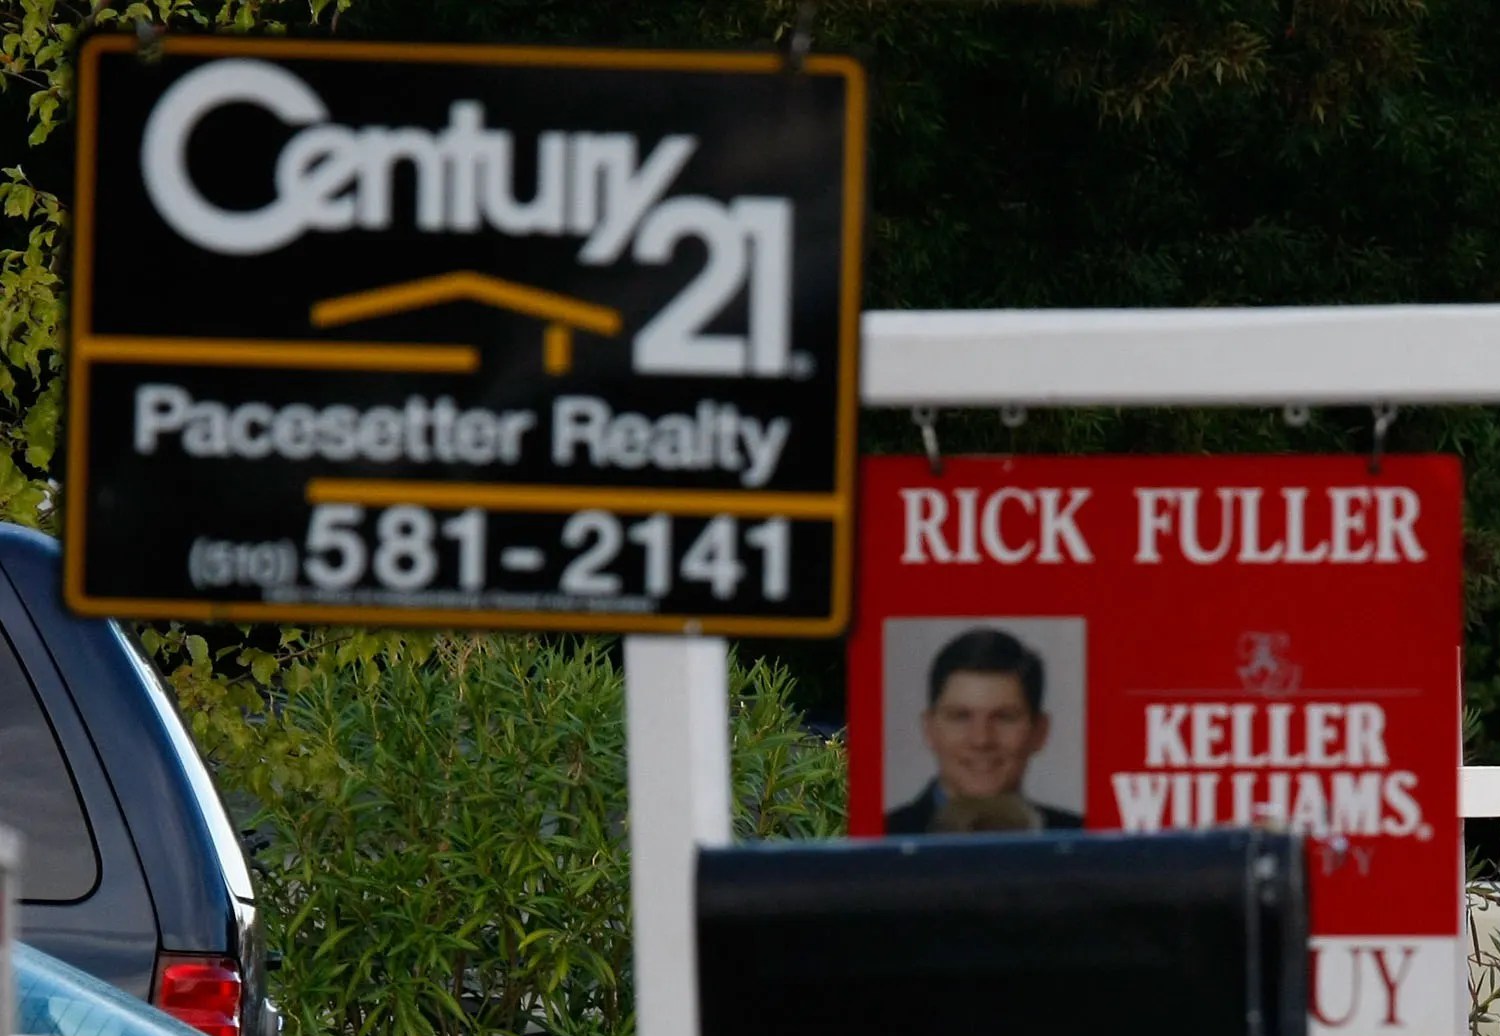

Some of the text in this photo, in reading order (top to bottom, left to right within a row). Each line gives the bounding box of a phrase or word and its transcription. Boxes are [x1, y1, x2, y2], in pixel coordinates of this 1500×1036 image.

[142, 59, 793, 377] Century 21
[134, 386, 787, 487] Pacesetter Realty
[900, 487, 1424, 563] RICK FULLER
[1145, 703, 1388, 768] KELLER
[1309, 947, 1416, 1026] UY
